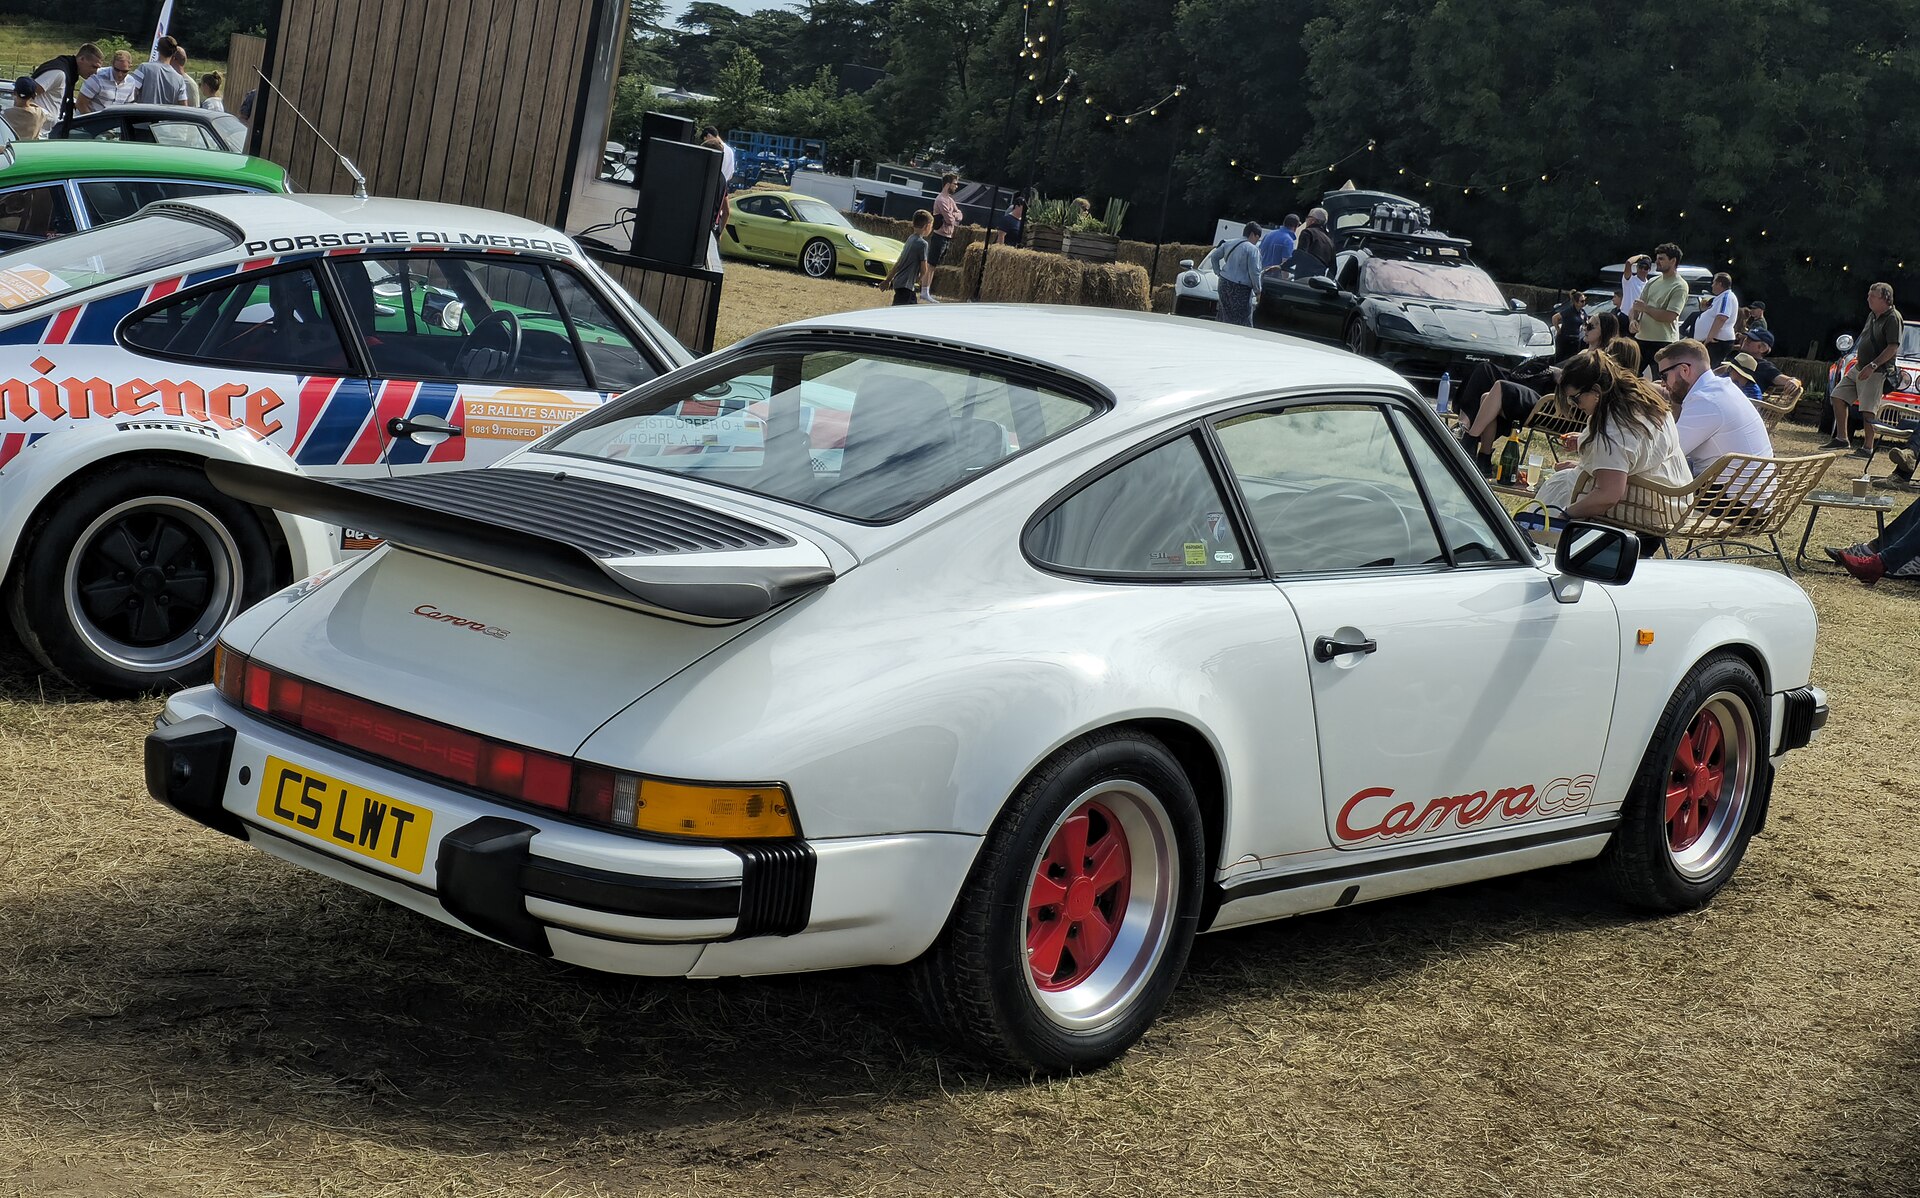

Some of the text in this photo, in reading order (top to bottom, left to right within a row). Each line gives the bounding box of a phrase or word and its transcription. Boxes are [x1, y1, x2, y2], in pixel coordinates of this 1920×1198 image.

[245, 231, 411, 256] PORSCHE
[469, 404, 588, 420] 23 RALLYE SANRE
[115, 420, 220, 440] PIRELLI
[471, 425, 490, 434] 1981
[414, 605, 485, 632] Carrera
[332, 789, 415, 859] LWT
[1336, 784, 1538, 841] Carrera
